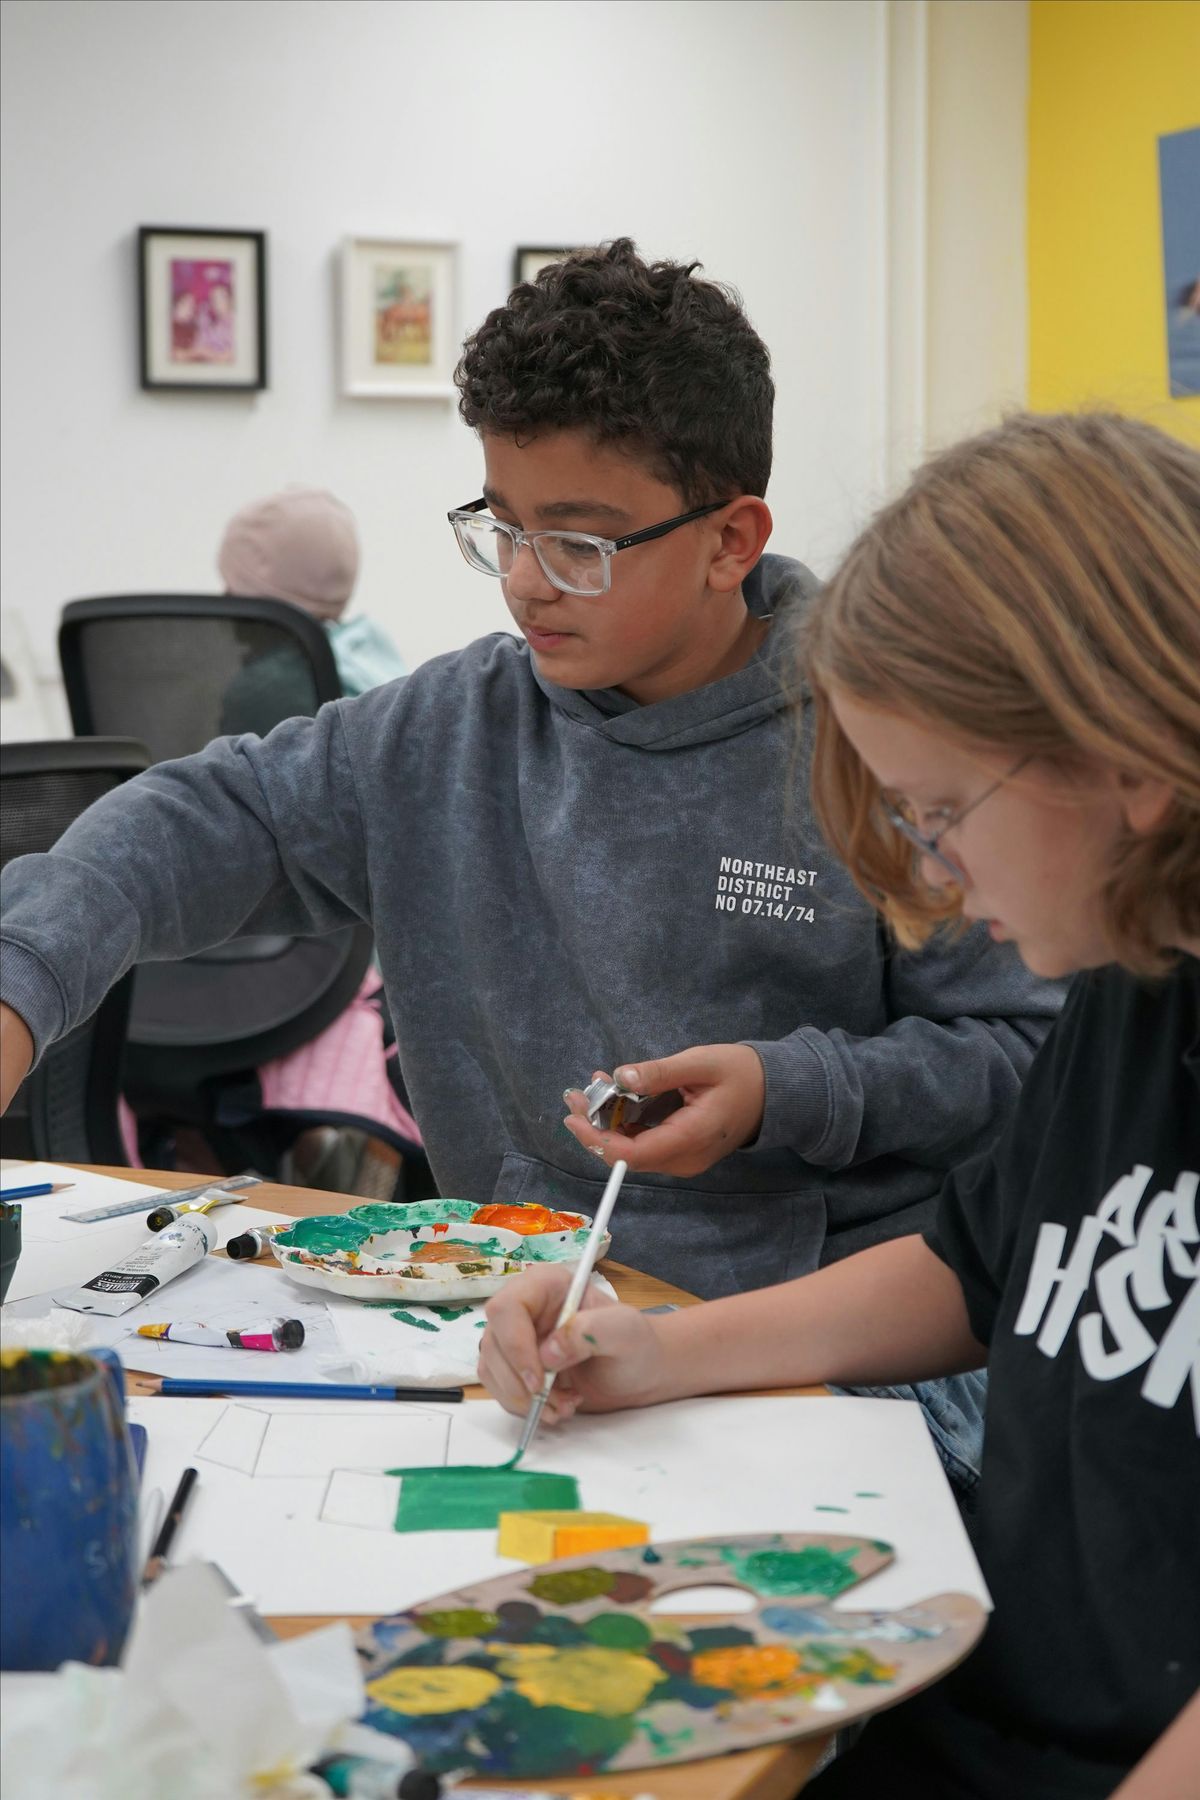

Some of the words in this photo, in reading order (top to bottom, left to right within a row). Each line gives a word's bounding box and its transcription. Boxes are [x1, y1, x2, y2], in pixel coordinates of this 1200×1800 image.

[720, 857, 817, 886] NORTHEAST
[718, 876, 793, 901] DISTRICT
[715, 894, 737, 912] NO
[742, 898, 815, 923] 07.14/74
